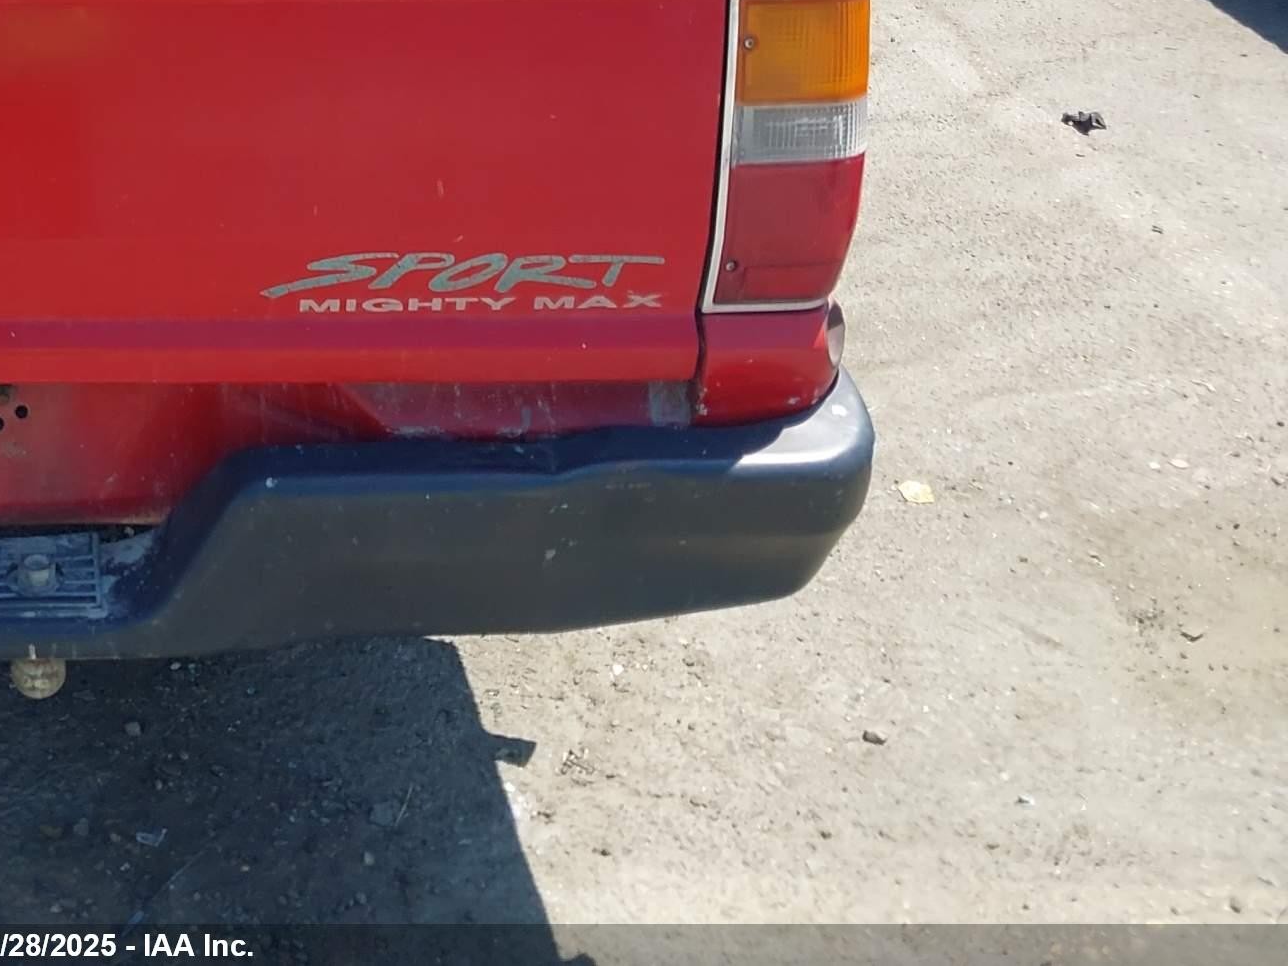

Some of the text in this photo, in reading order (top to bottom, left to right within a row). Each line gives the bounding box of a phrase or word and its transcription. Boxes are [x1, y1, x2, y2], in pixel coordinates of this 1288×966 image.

[260, 252, 665, 299] SPORT
[299, 294, 663, 313] MIGHTY MAX
